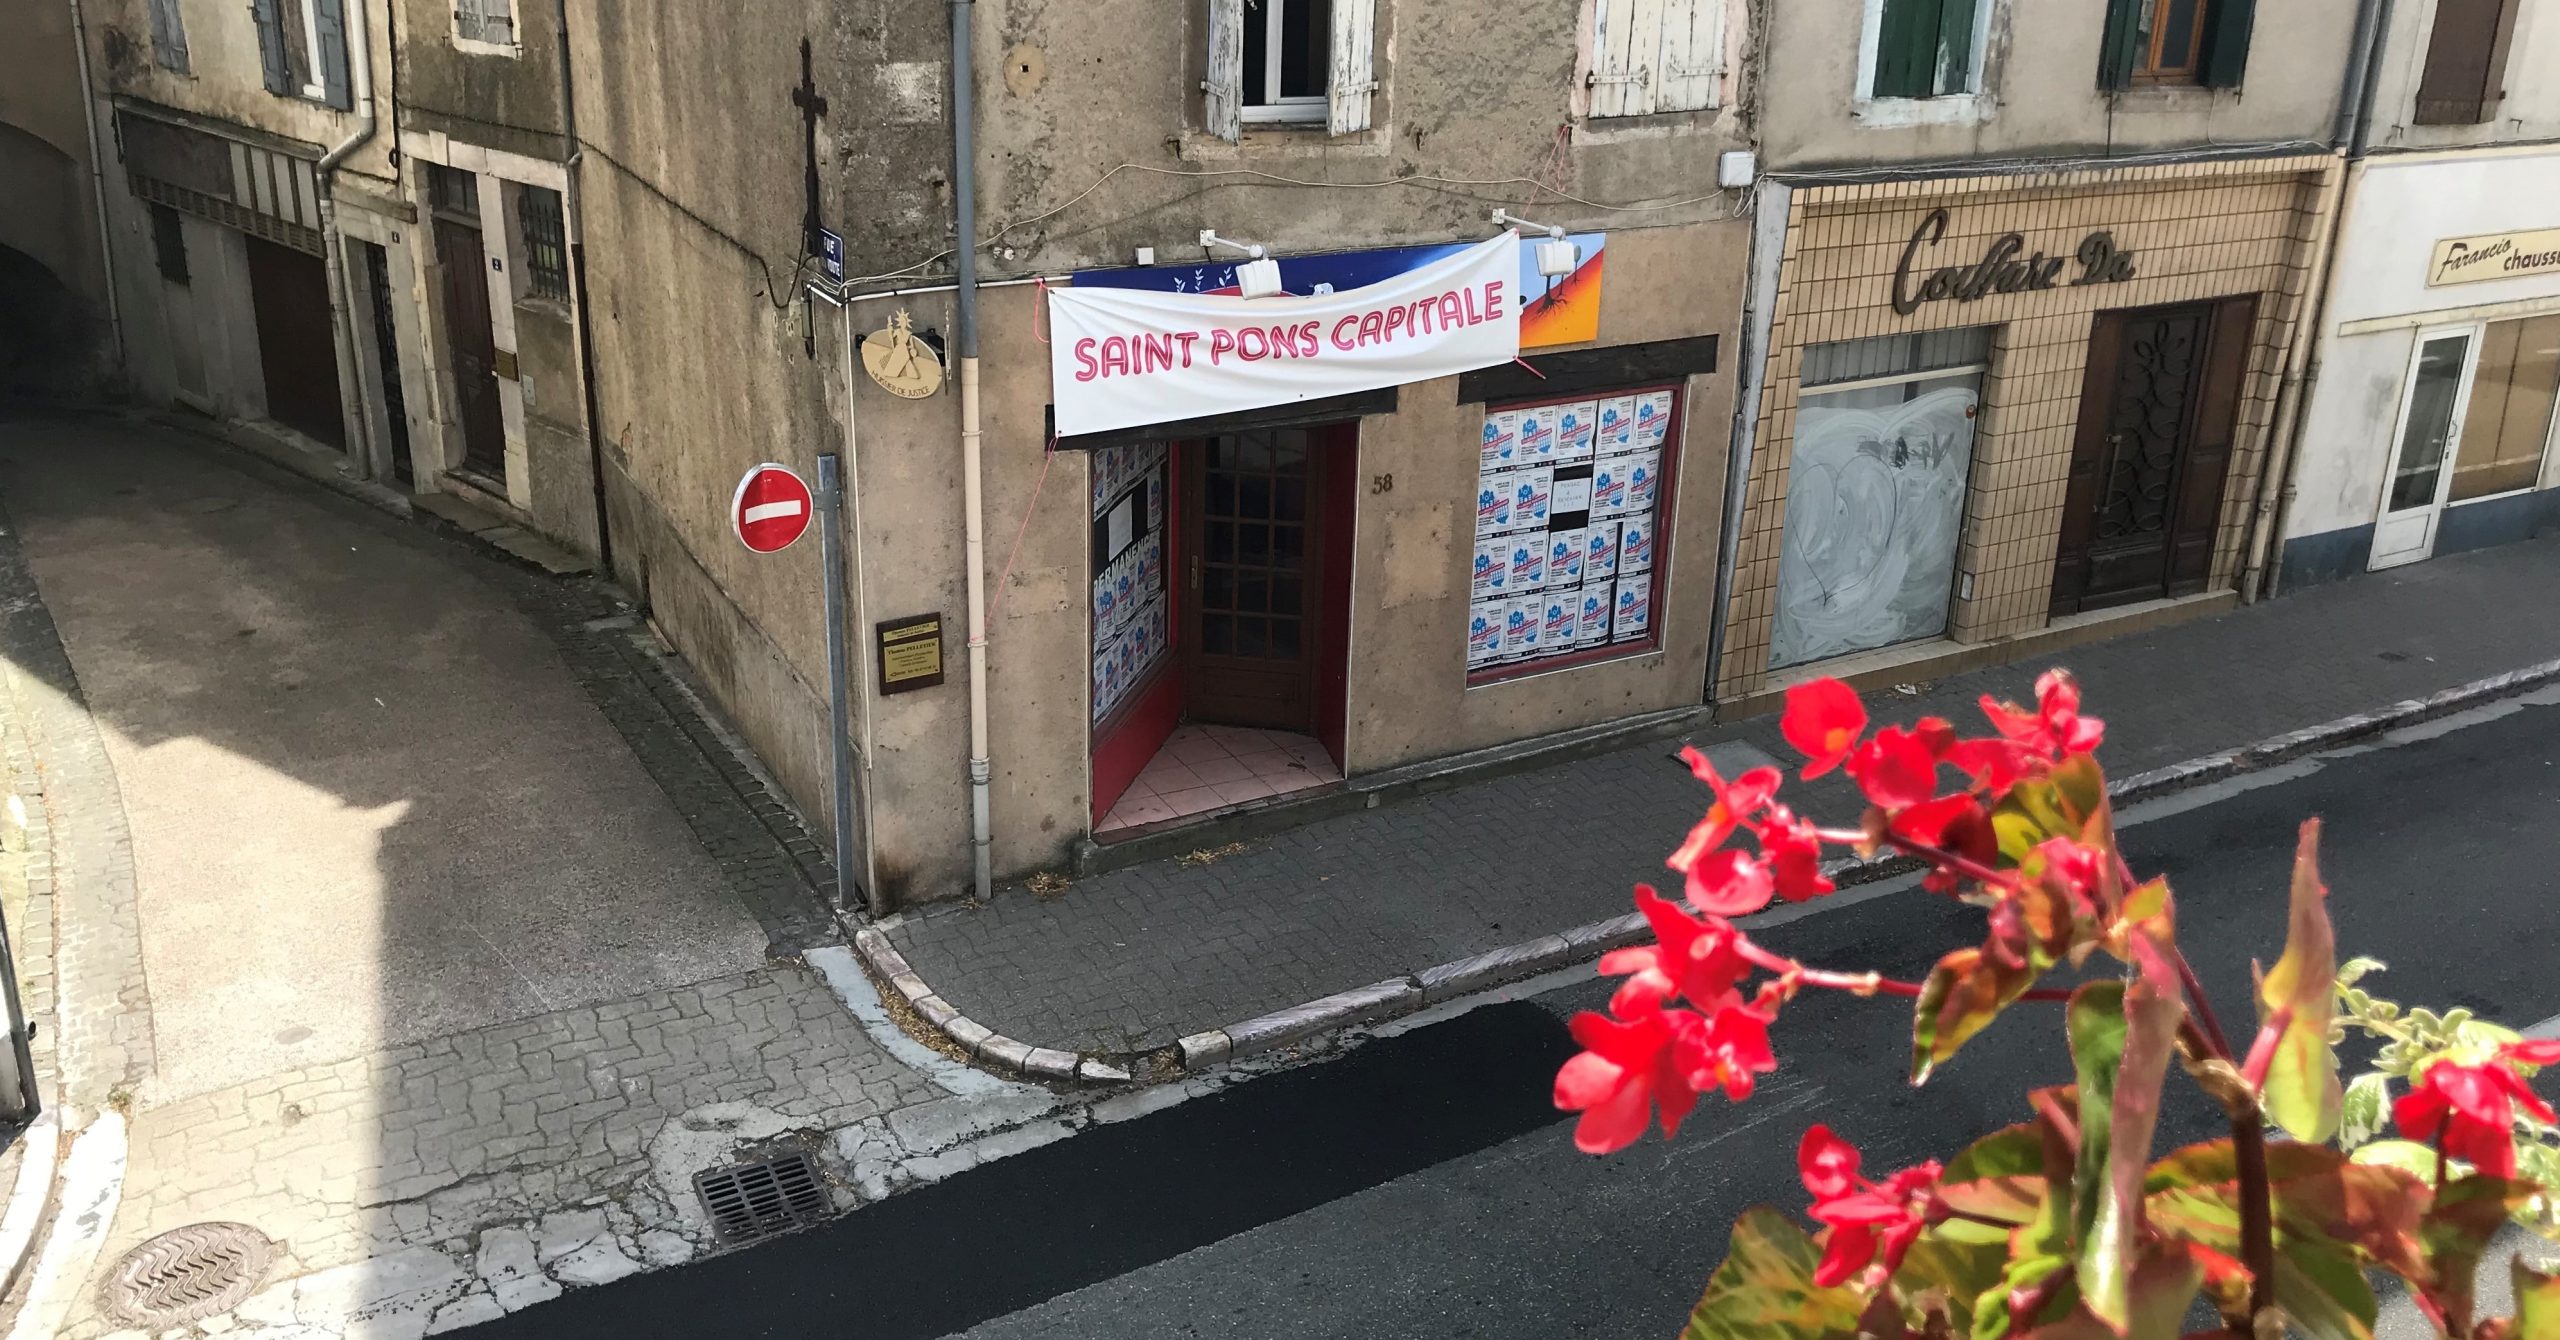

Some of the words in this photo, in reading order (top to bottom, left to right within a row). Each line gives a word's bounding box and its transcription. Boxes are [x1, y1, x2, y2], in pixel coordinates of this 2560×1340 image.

[2436, 238, 2512, 282] Farancio
[1074, 331, 1200, 382] SAINT
[1210, 320, 1320, 366] PONS
[1330, 280, 1504, 351] CAPITALE
[897, 388, 905, 396] DE
[908, 385, 930, 397] JUSTICE
[1371, 472, 1393, 495] 58
